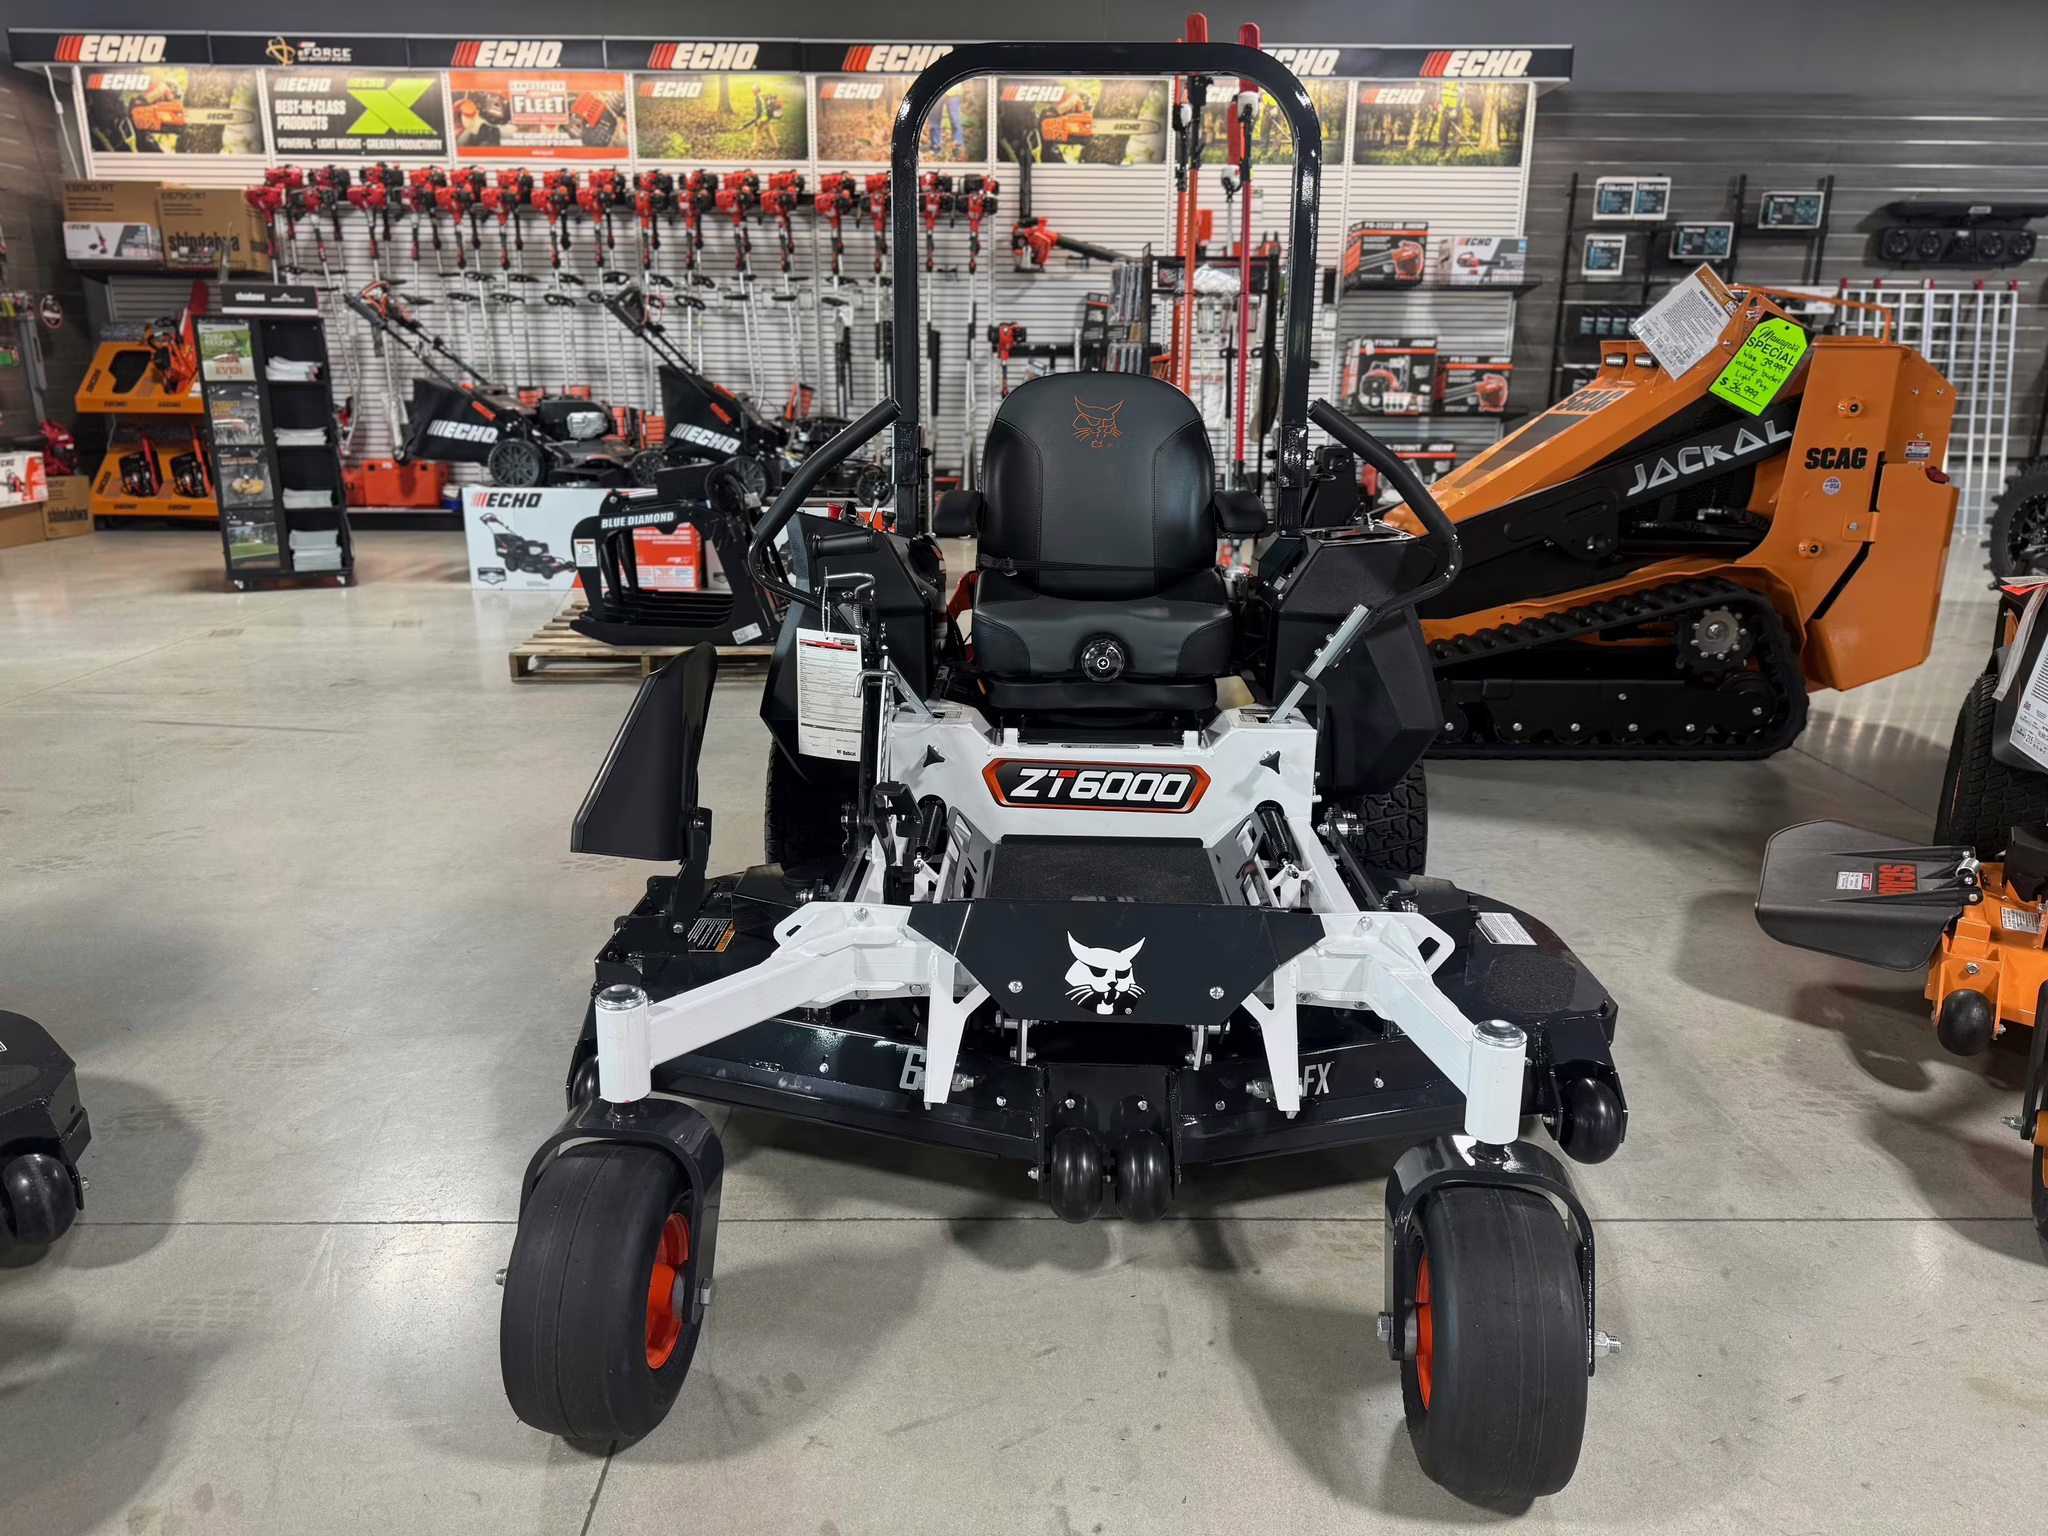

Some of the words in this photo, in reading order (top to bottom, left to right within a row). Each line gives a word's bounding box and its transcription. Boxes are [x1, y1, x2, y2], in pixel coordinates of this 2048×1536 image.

[78, 35, 167, 62] ECHO
[474, 41, 563, 68] ECHO
[670, 43, 759, 70] ECHO
[1262, 49, 1340, 76] CHO
[1449, 51, 1532, 77] ECHO
[101, 74, 150, 91] ECHO
[285, 78, 332, 92] ECHO
[653, 82, 702, 98] ECHO
[833, 83, 884, 99] ECHO
[1015, 85, 1066, 102] ECHO
[1376, 89, 1426, 105] ECHO
[275, 99, 347, 115] BEST-IN-CLASS
[514, 95, 564, 113] FLEET
[277, 116, 329, 130] PRODUCTS
[277, 138, 313, 149] POWERFUL
[1465, 237, 1492, 247] ECHO
[1746, 336, 1795, 367] SPECIAL
[1553, 389, 1627, 412] SCAG
[443, 421, 499, 444] ECHO
[687, 425, 741, 454] ECHO
[1626, 420, 1793, 497] JACKAL
[1804, 447, 1868, 470] SCAG
[486, 493, 542, 508] ECHO
[601, 516, 626, 529] BLUE
[627, 512, 674, 526] DIAMOND
[1010, 768, 1191, 802] ZT6000
